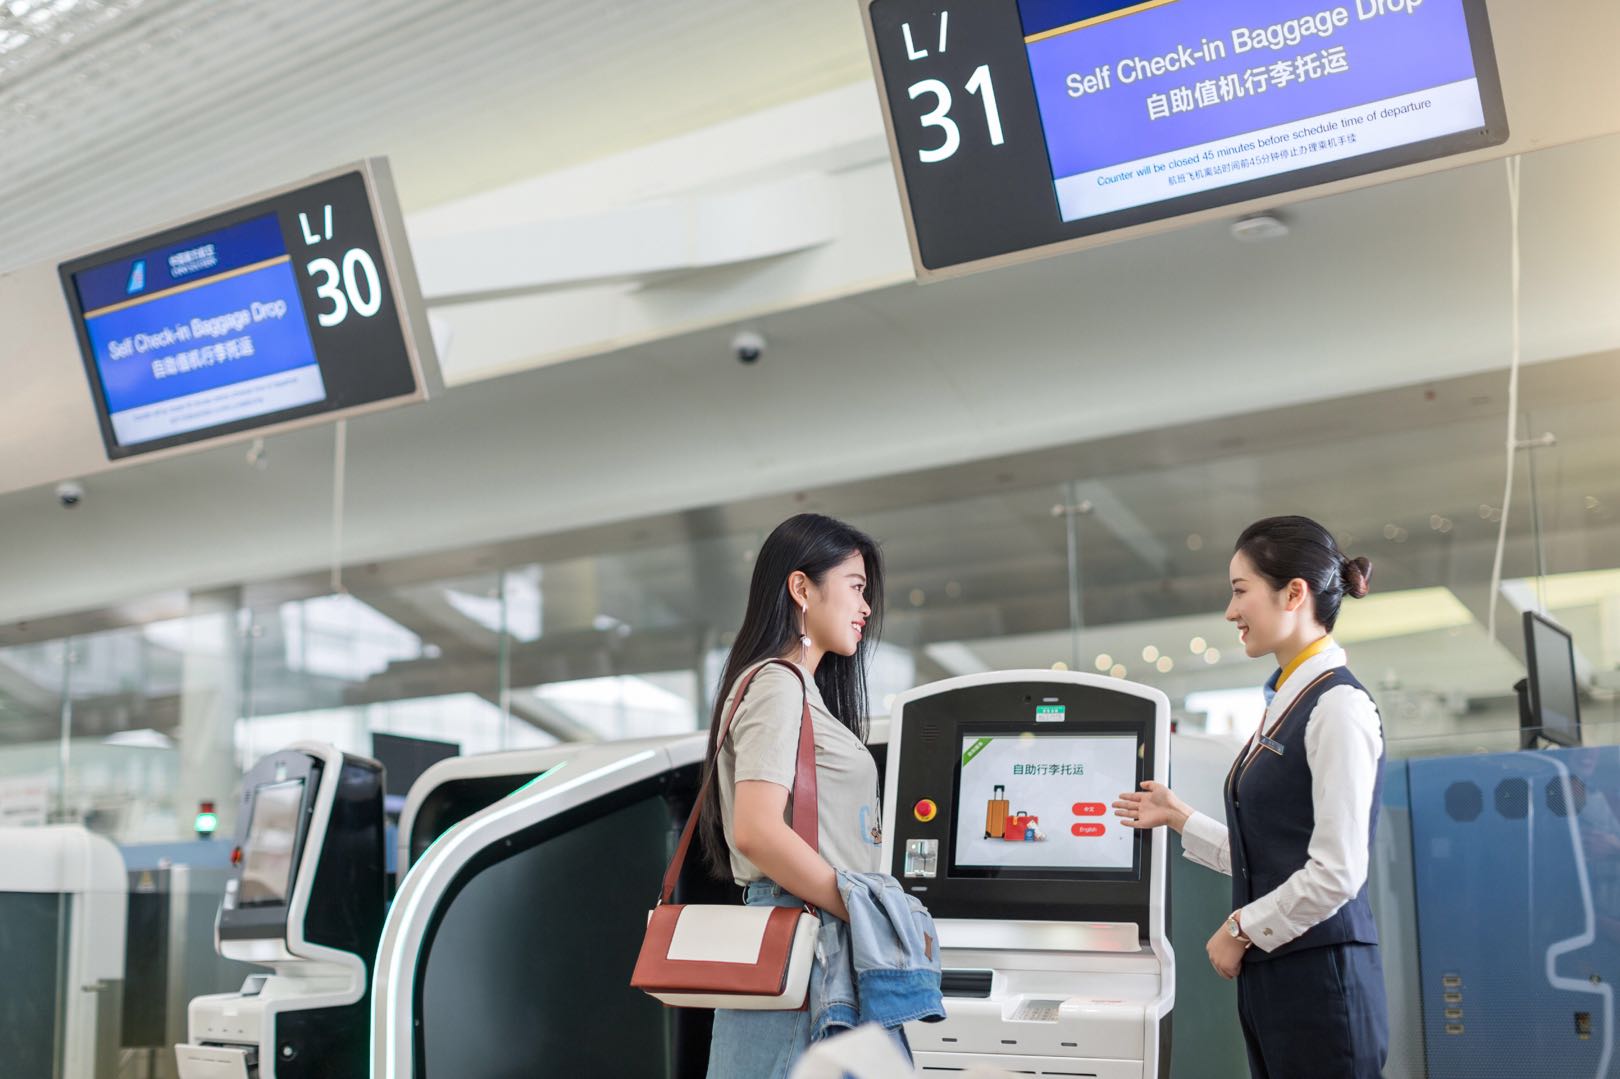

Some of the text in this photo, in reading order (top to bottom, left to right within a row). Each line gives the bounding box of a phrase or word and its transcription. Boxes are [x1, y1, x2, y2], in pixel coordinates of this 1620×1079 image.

[1066, 67, 1111, 98] Self
[1117, 39, 1226, 85] Check-in
[1232, 6, 1350, 52] Baggage
[1146, 46, 1350, 121] 自助值机行李托运
[907, 64, 1005, 163] 31
[1096, 98, 1432, 186] Counter will be closed 45 minutes before schedule time of departure
[306, 247, 382, 327] 30
[107, 299, 288, 361] Self Check-in Baggage Drop
[1013, 763, 1084, 775] 自助行李托运
